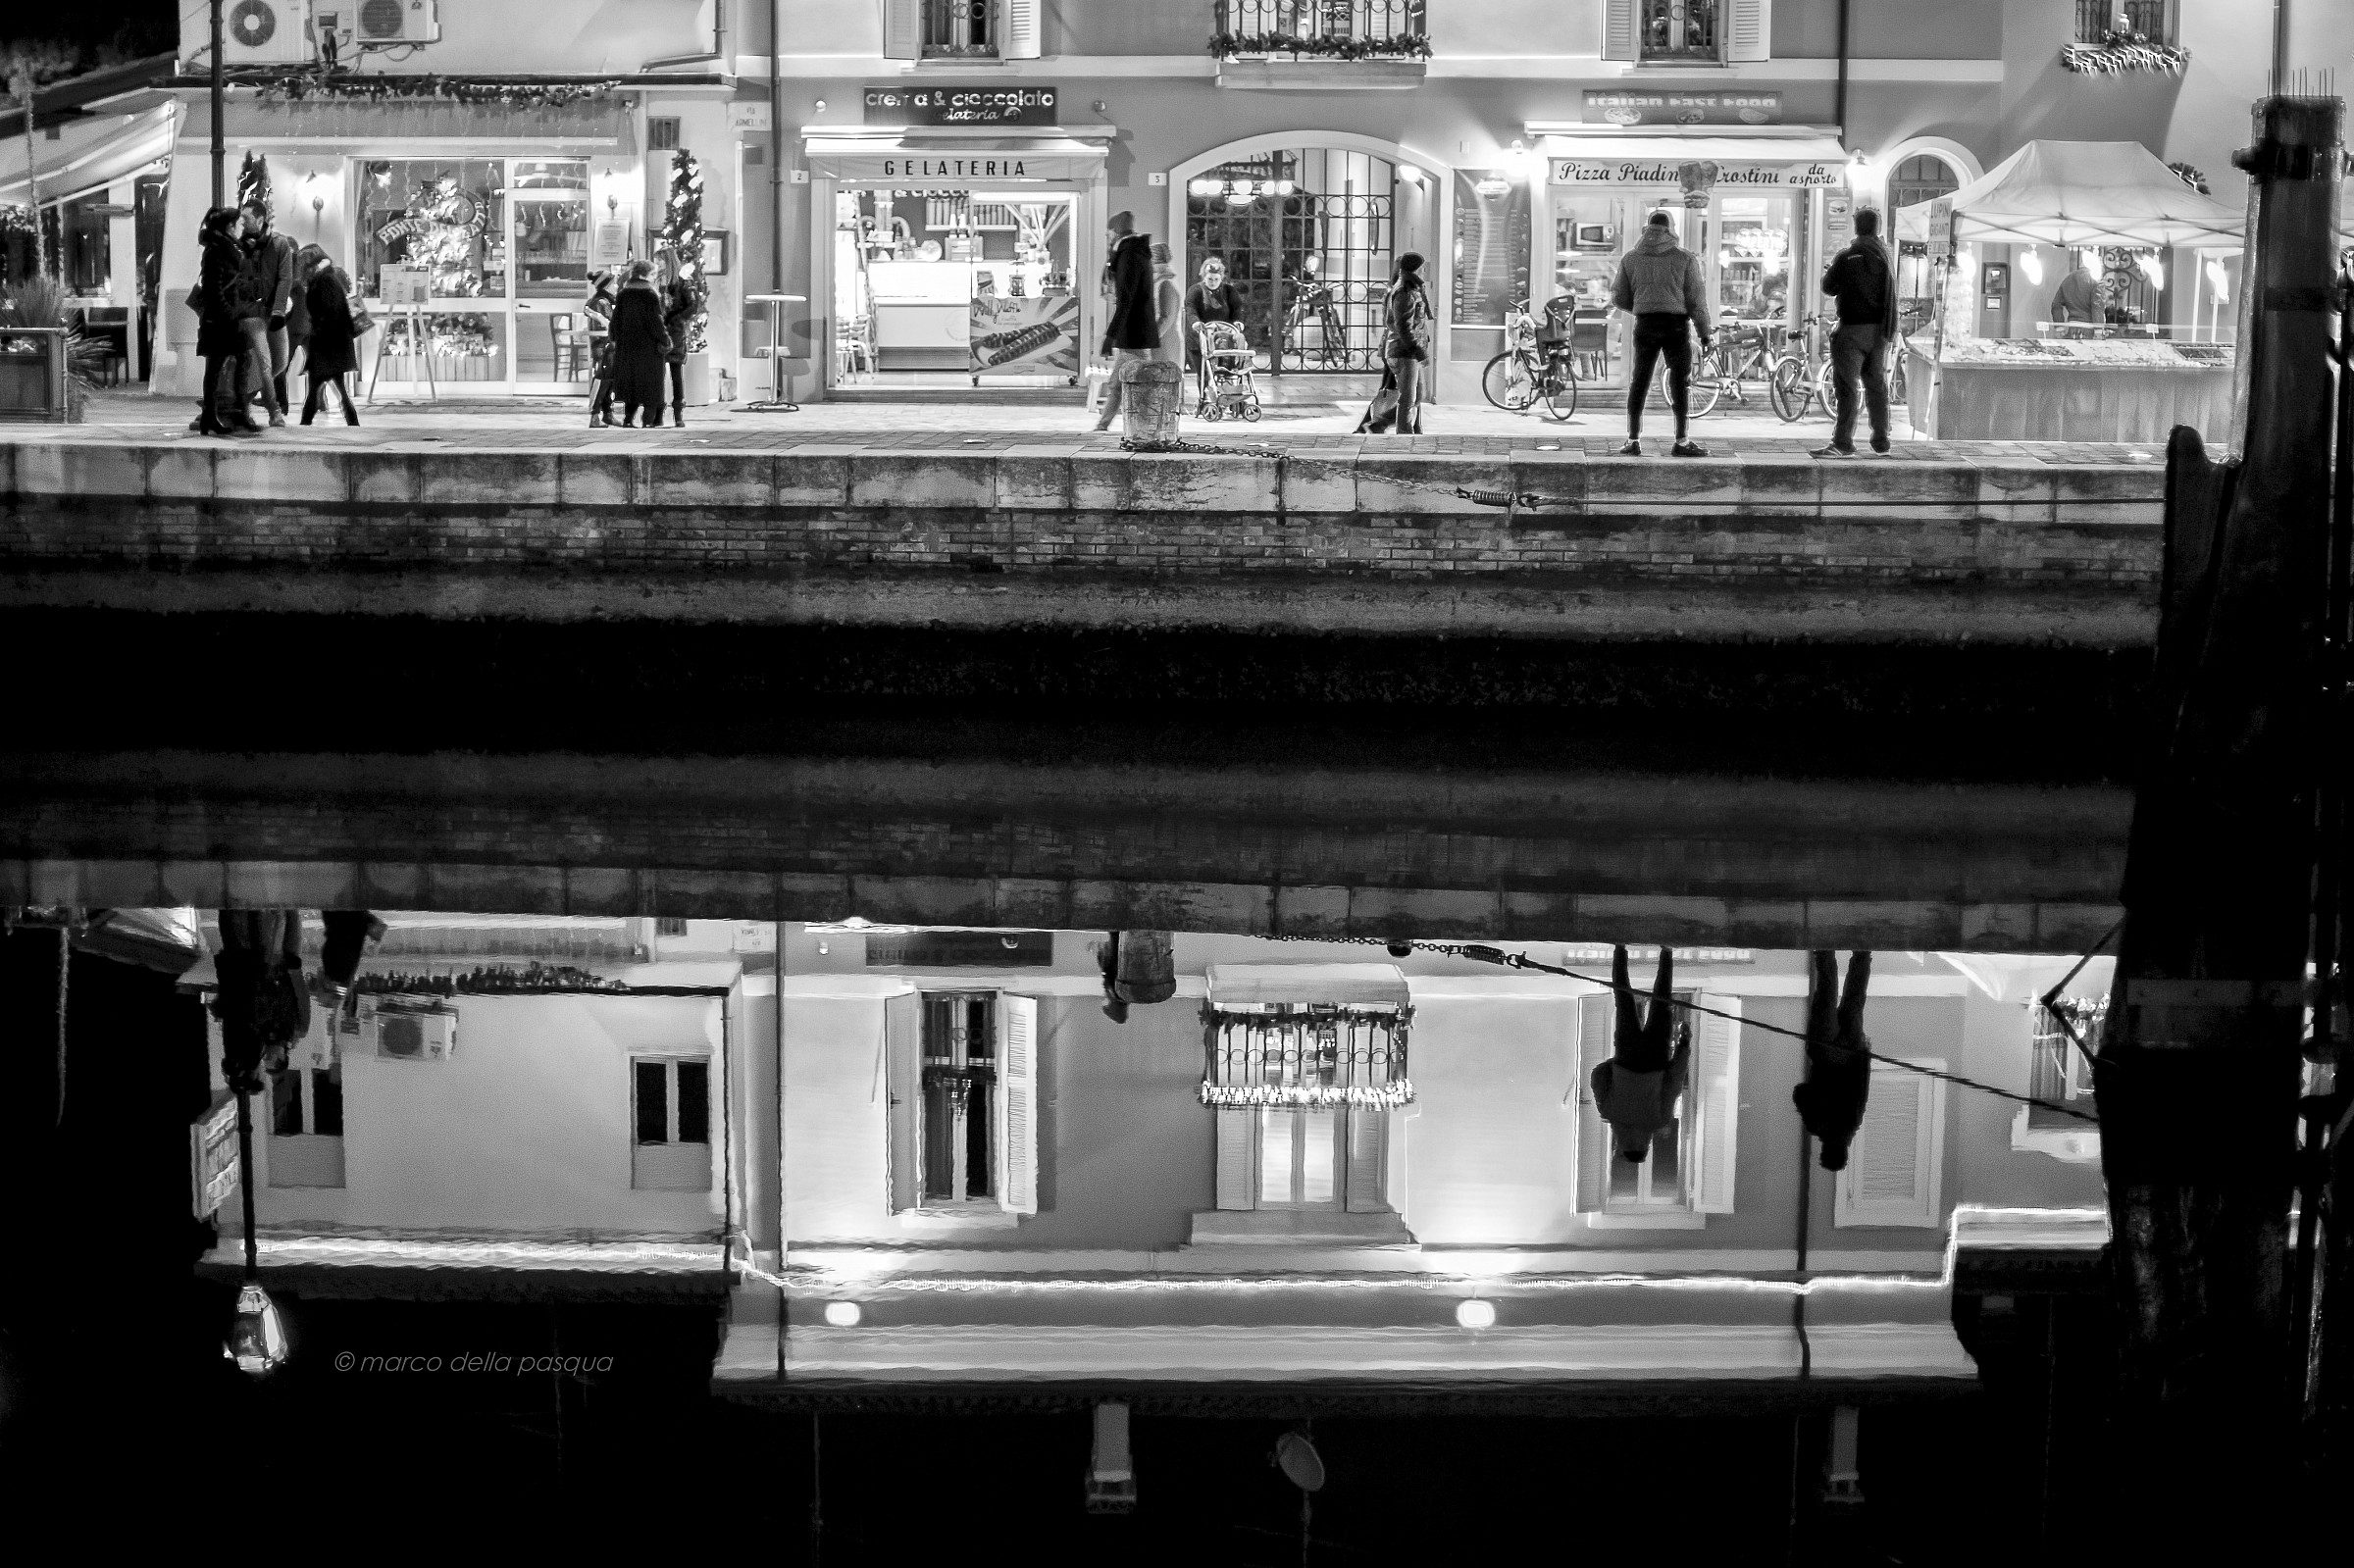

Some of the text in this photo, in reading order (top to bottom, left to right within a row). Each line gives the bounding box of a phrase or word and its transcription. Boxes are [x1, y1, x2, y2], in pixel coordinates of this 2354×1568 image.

[934, 90, 947, 106] &
[885, 160, 1025, 176] GELATERIA
[1559, 162, 1611, 180] Pizza
[1617, 163, 1679, 181] Piadin
[1808, 163, 1825, 175] da
[1789, 174, 1837, 187] asporto
[379, 218, 425, 246] PONTE
